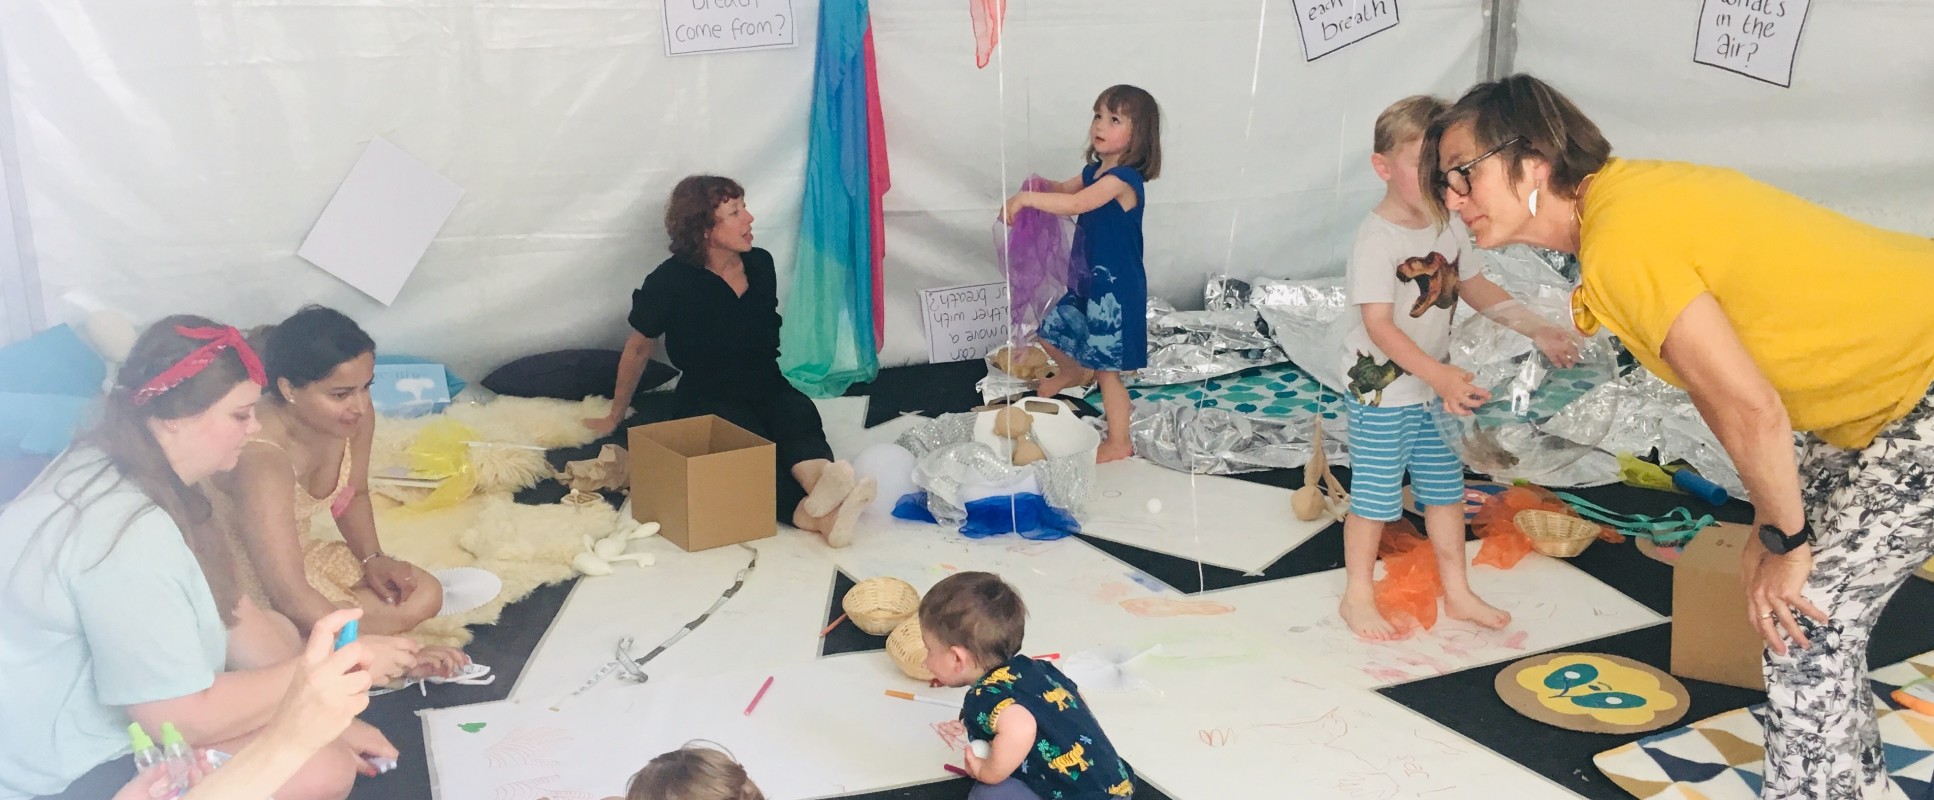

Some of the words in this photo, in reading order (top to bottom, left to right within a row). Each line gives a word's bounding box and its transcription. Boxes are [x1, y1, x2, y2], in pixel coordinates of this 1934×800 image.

[675, 24, 722, 42] come
[731, 14, 786, 40] from?
[1321, 0, 1387, 41] breath
[1716, 14, 1731, 27] in
[1742, 15, 1776, 39] the
[1716, 33, 1759, 68] air?
[929, 288, 987, 312] breath?
[933, 311, 965, 328] with
[948, 332, 960, 344] a
[965, 326, 997, 342] move
[950, 346, 976, 361] can
